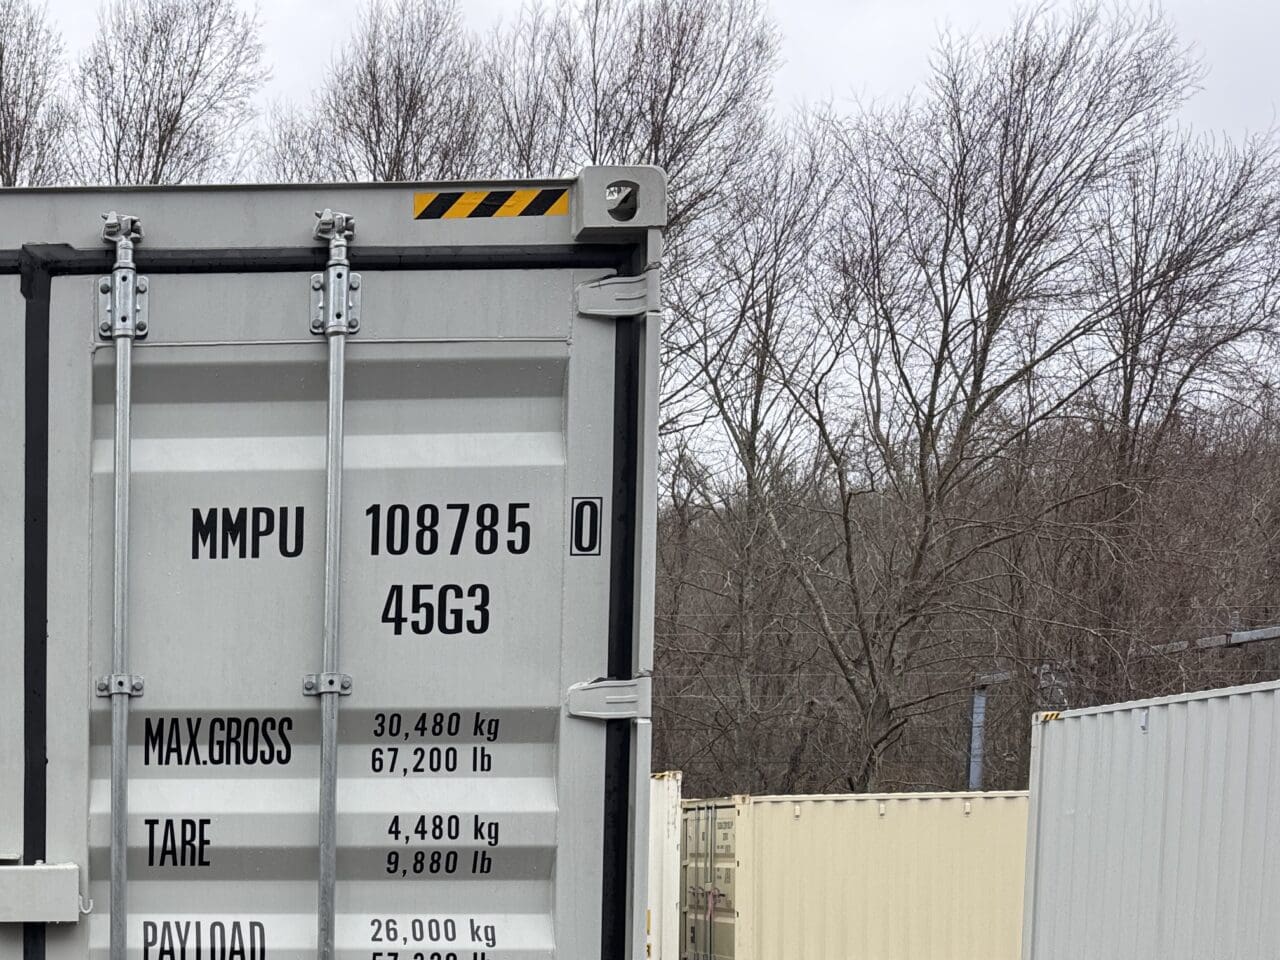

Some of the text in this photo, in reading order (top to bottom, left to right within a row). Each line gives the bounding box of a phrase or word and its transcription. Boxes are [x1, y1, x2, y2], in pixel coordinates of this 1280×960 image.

[192, 500, 599, 559] MMPU 108785 0
[381, 584, 490, 636] 45G3
[144, 717, 293, 766] MAX.GROSS
[373, 712, 500, 742] 30,480 kg
[371, 746, 492, 776] 67,200 lb
[144, 819, 211, 867] TARE
[388, 815, 499, 846] 4,480 kg
[386, 851, 492, 877] 9,880 lb
[370, 919, 496, 948] 26,000 kg
